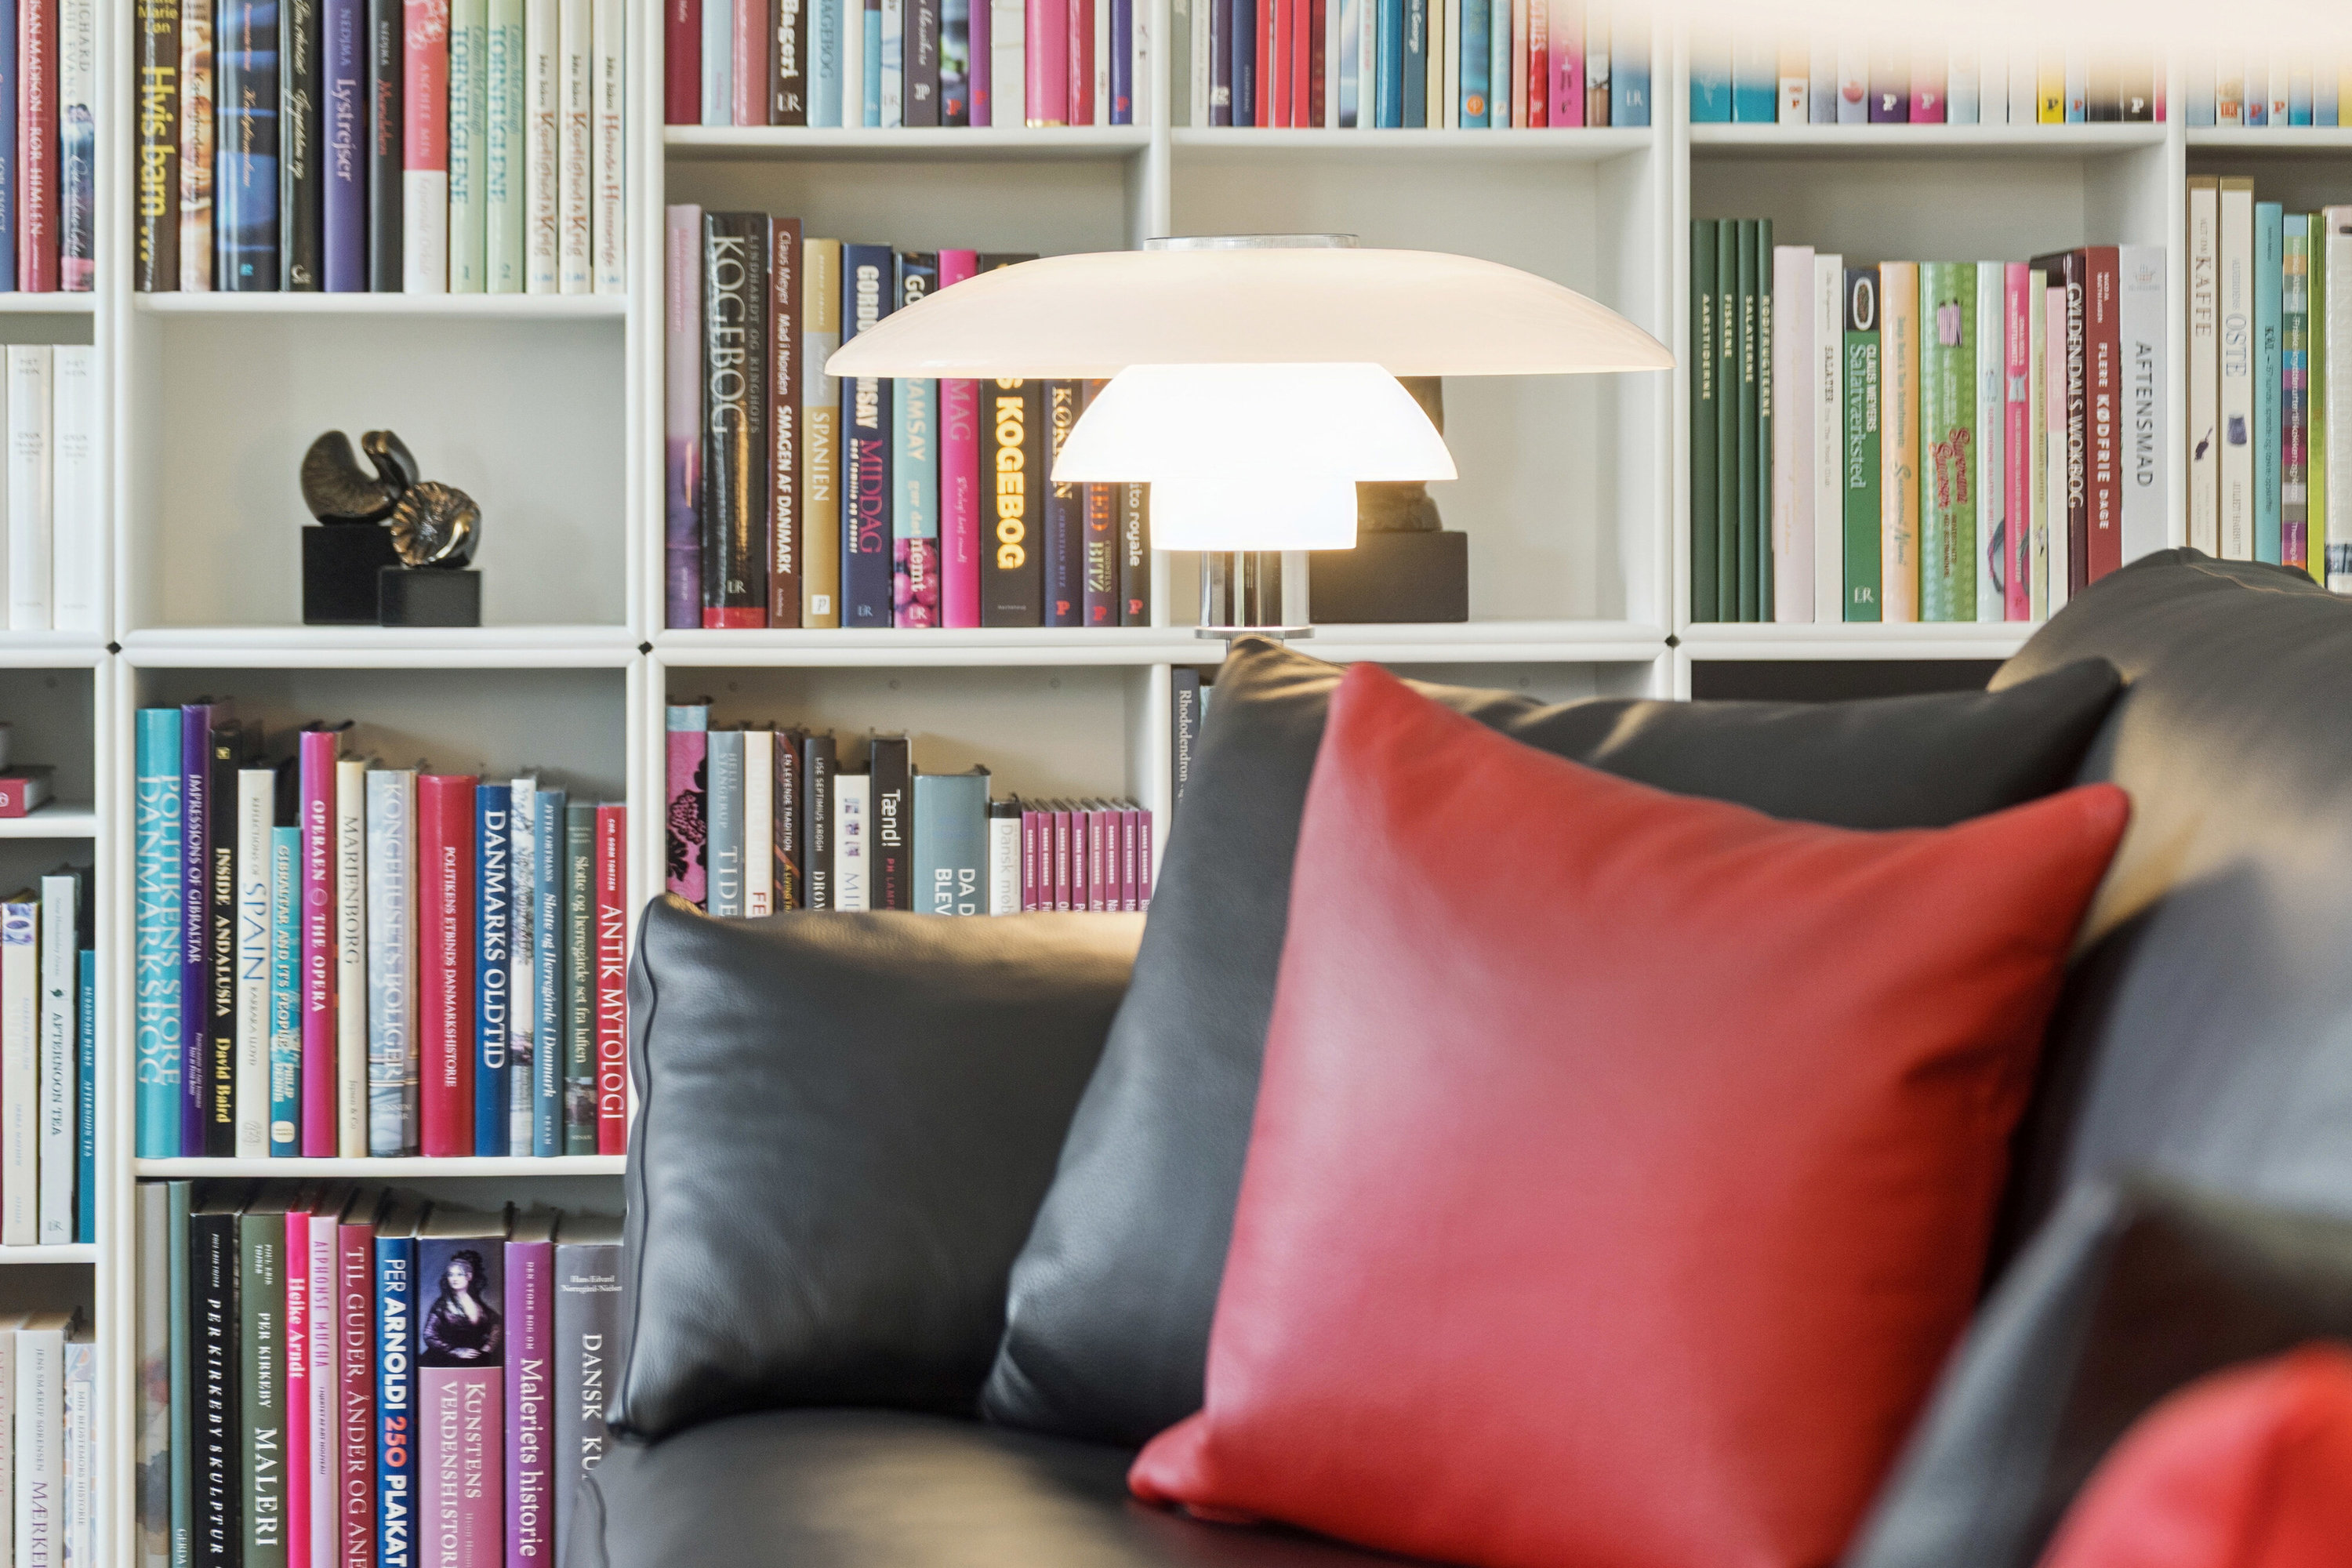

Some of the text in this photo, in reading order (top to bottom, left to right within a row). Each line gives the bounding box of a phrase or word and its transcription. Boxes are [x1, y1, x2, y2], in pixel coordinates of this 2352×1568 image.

[29, 39, 42, 111] MADISON
[778, 0, 800, 78] Bageri
[1409, 13, 1422, 53] George
[141, 66, 176, 216] Hvis barn
[331, 78, 356, 182] Lystrejser
[2131, 96, 2144, 114] P
[29, 168, 42, 235] HIMLEN
[710, 235, 746, 433] KOGEBOG
[775, 230, 791, 395] Claus Meyer Mad Norden
[1702, 293, 1711, 401] AARSTIDERNE
[1724, 293, 1733, 358] FISKENE
[1745, 294, 1754, 383] SALATERNE
[2194, 256, 2212, 337] KAFFE
[2226, 314, 2248, 376] OSTE
[1762, 295, 1771, 417] RODFRUGTERNE
[1824, 344, 1835, 404] SALATER
[1865, 343, 1877, 433] CLAUS MEYERS
[2067, 282, 2082, 509] GYLDENDALS WOKBOG
[2135, 340, 2153, 488] AFTENSMAD
[811, 412, 830, 501] SPANIEN
[1849, 343, 1867, 490] Salatværksted
[2096, 342, 2111, 529] FLERE KØDFRIE DAGE
[776, 405, 792, 574] SMAGEN AF DANMARK
[849, 438, 858, 554] med familie venner
[859, 439, 883, 554] MIDDAG
[994, 396, 1025, 570] KOGEBOG
[1126, 511, 1143, 567] royale
[909, 538, 927, 593] nemt
[1087, 541, 1105, 593] BITZ
[1178, 689, 1192, 782] Rhododendron
[783, 753, 793, 851] EN LEVENDE TRADITION
[815, 757, 825, 851] LISE SEPTIMIUS KROGH
[880, 788, 902, 847] Tænd!
[1000, 824, 1014, 873] Dansk
[188, 773, 203, 964] IMPRESSIONS OF GIBRALTAR
[310, 799, 327, 1013] OPERAEN THE OPERA
[343, 815, 361, 965] MARIENBORG
[935, 868, 953, 916] BLEV
[958, 868, 975, 897] DA
[136, 774, 162, 1085] DANMARKSBOG
[159, 774, 181, 1085] POLITIKENS STORE
[215, 848, 232, 1123] INSIDE ANDALUSIA David Baird
[243, 882, 268, 1033] SPAIN BARBARA
[276, 844, 291, 1048] GIBRALTAR AND ITS PEOPLE
[383, 782, 405, 1082] KONGEHUSETS BOLIGER
[444, 846, 457, 1087] POLITIKENS ETBINDS DANMARKSHISTORIE
[483, 809, 507, 1070] DANMARKS OLDTID
[572, 855, 591, 1063] Slotte og herregårde set fra luften
[540, 892, 557, 1098] Slotte og Herregårde Danmark
[601, 903, 624, 1119] ANTIK MYTOLOGI
[51, 1012, 63, 1138] AFTERNOON TEA
[83, 986, 93, 1158] SUSANNAH BLAKE AFTERNOON TEA
[273, 1062, 285, 1103] DENNIS
[283, 1062, 295, 1098] PHILIP
[263, 1243, 274, 1287] POUL ERIK
[314, 1240, 330, 1367] ALPHONSE MUCHA
[525, 1261, 535, 1350] DEN STORE BOG OM
[258, 1312, 272, 1409] PER KIRKEBY
[288, 1277, 307, 1379] Heike Arndt
[344, 1246, 371, 1515] TIL GUDER, ÅNDER OG
[383, 1258, 407, 1468] PER ARNOLDI 250
[581, 1333, 603, 1421] DANSK
[34, 1348, 45, 1472] JENS SMÆRUP SØRENSEN
[77, 1390, 86, 1526] MIN BEDSTEMORS HISTORIE
[207, 1298, 223, 1554] PER KIRKEBY SKULPTUR
[318, 1442, 327, 1475] NOUVEAU
[463, 1382, 487, 1498] KUNSTENS
[519, 1357, 545, 1557] Maleriets historie
[254, 1426, 278, 1548] MALERI
[176, 1528, 188, 1565] GERDA
